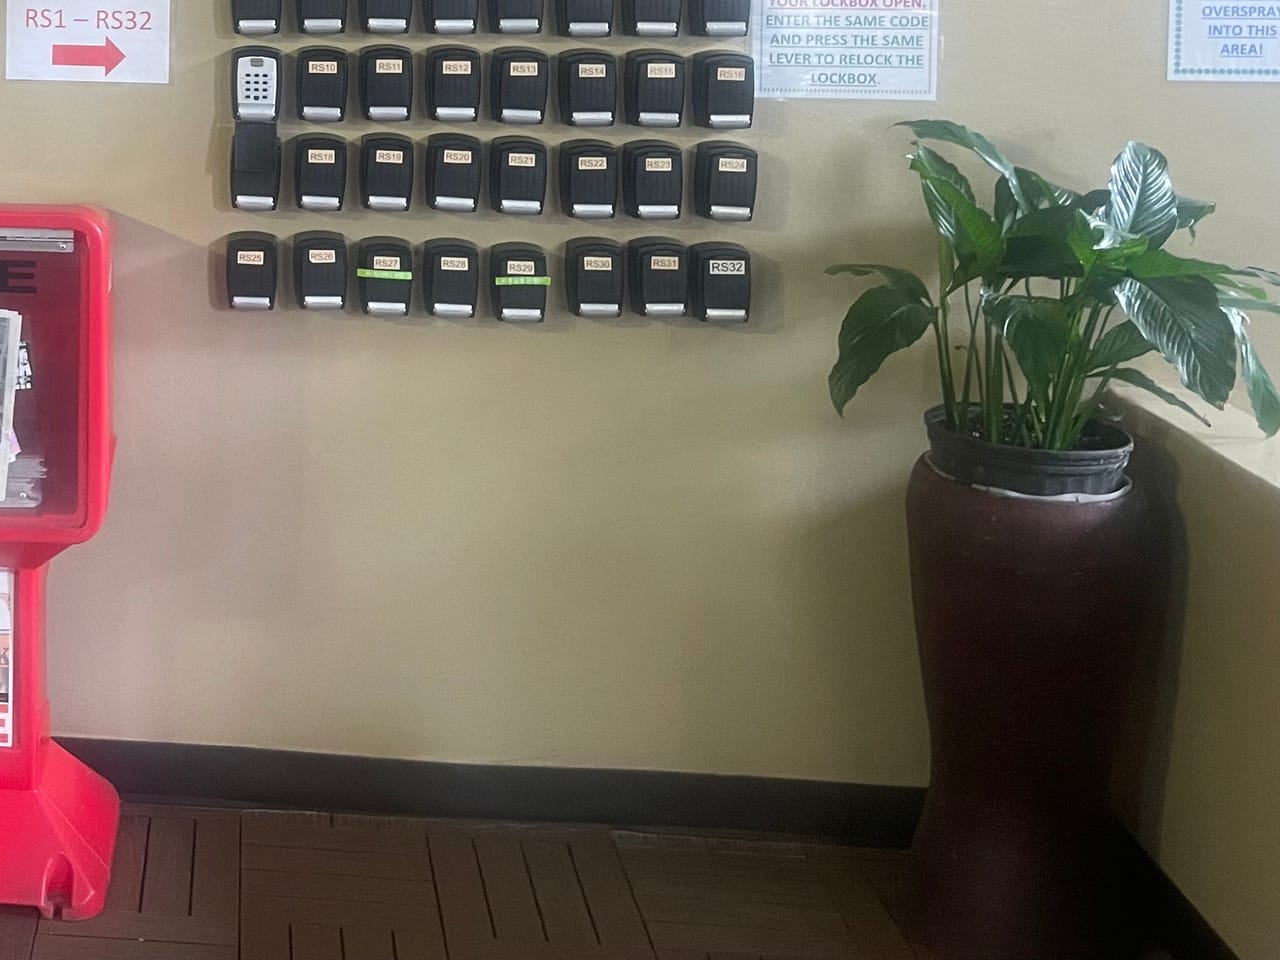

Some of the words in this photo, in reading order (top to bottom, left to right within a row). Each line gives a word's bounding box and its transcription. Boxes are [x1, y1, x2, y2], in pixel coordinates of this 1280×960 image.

[26, 8, 66, 29] RS1
[96, 10, 152, 30] RS32
[766, 15, 810, 26] ENTER
[814, 15, 841, 27] THE
[845, 15, 885, 27] SAME
[890, 16, 929, 28] CODE
[1208, 25, 1243, 36] INTO
[1246, 25, 1278, 36] THIS
[770, 34, 802, 45] AND
[806, 34, 848, 46] PRESS
[851, 34, 878, 46] THE
[882, 35, 924, 47] SAME
[1221, 43, 1263, 55] AREA!
[770, 53, 811, 65] LEVER
[815, 53, 835, 65] TO
[839, 54, 893, 66] RELOCK
[896, 54, 924, 66] THE
[311, 63, 336, 72] RS10
[378, 62, 400, 72] RS11
[445, 63, 470, 72] RS12
[512, 64, 537, 74] RS13
[580, 66, 605, 76] RS14
[720, 70, 744, 79] RS16
[811, 72, 880, 85] LOCKBOX.
[310, 152, 334, 162] RS18
[378, 152, 401, 161] RS19
[445, 152, 470, 162] RS20
[510, 155, 534, 165] RS21
[580, 159, 605, 168] RS22
[647, 159, 671, 169] RS23
[721, 160, 745, 170] RS24
[239, 253, 262, 263] RS25
[311, 252, 334, 262] RS26
[375, 258, 398, 267] RS27
[442, 259, 467, 269] RS28
[586, 259, 611, 269] RS30
[653, 258, 677, 268] RS31
[712, 262, 744, 273] RS32
[509, 263, 533, 273] RS29
